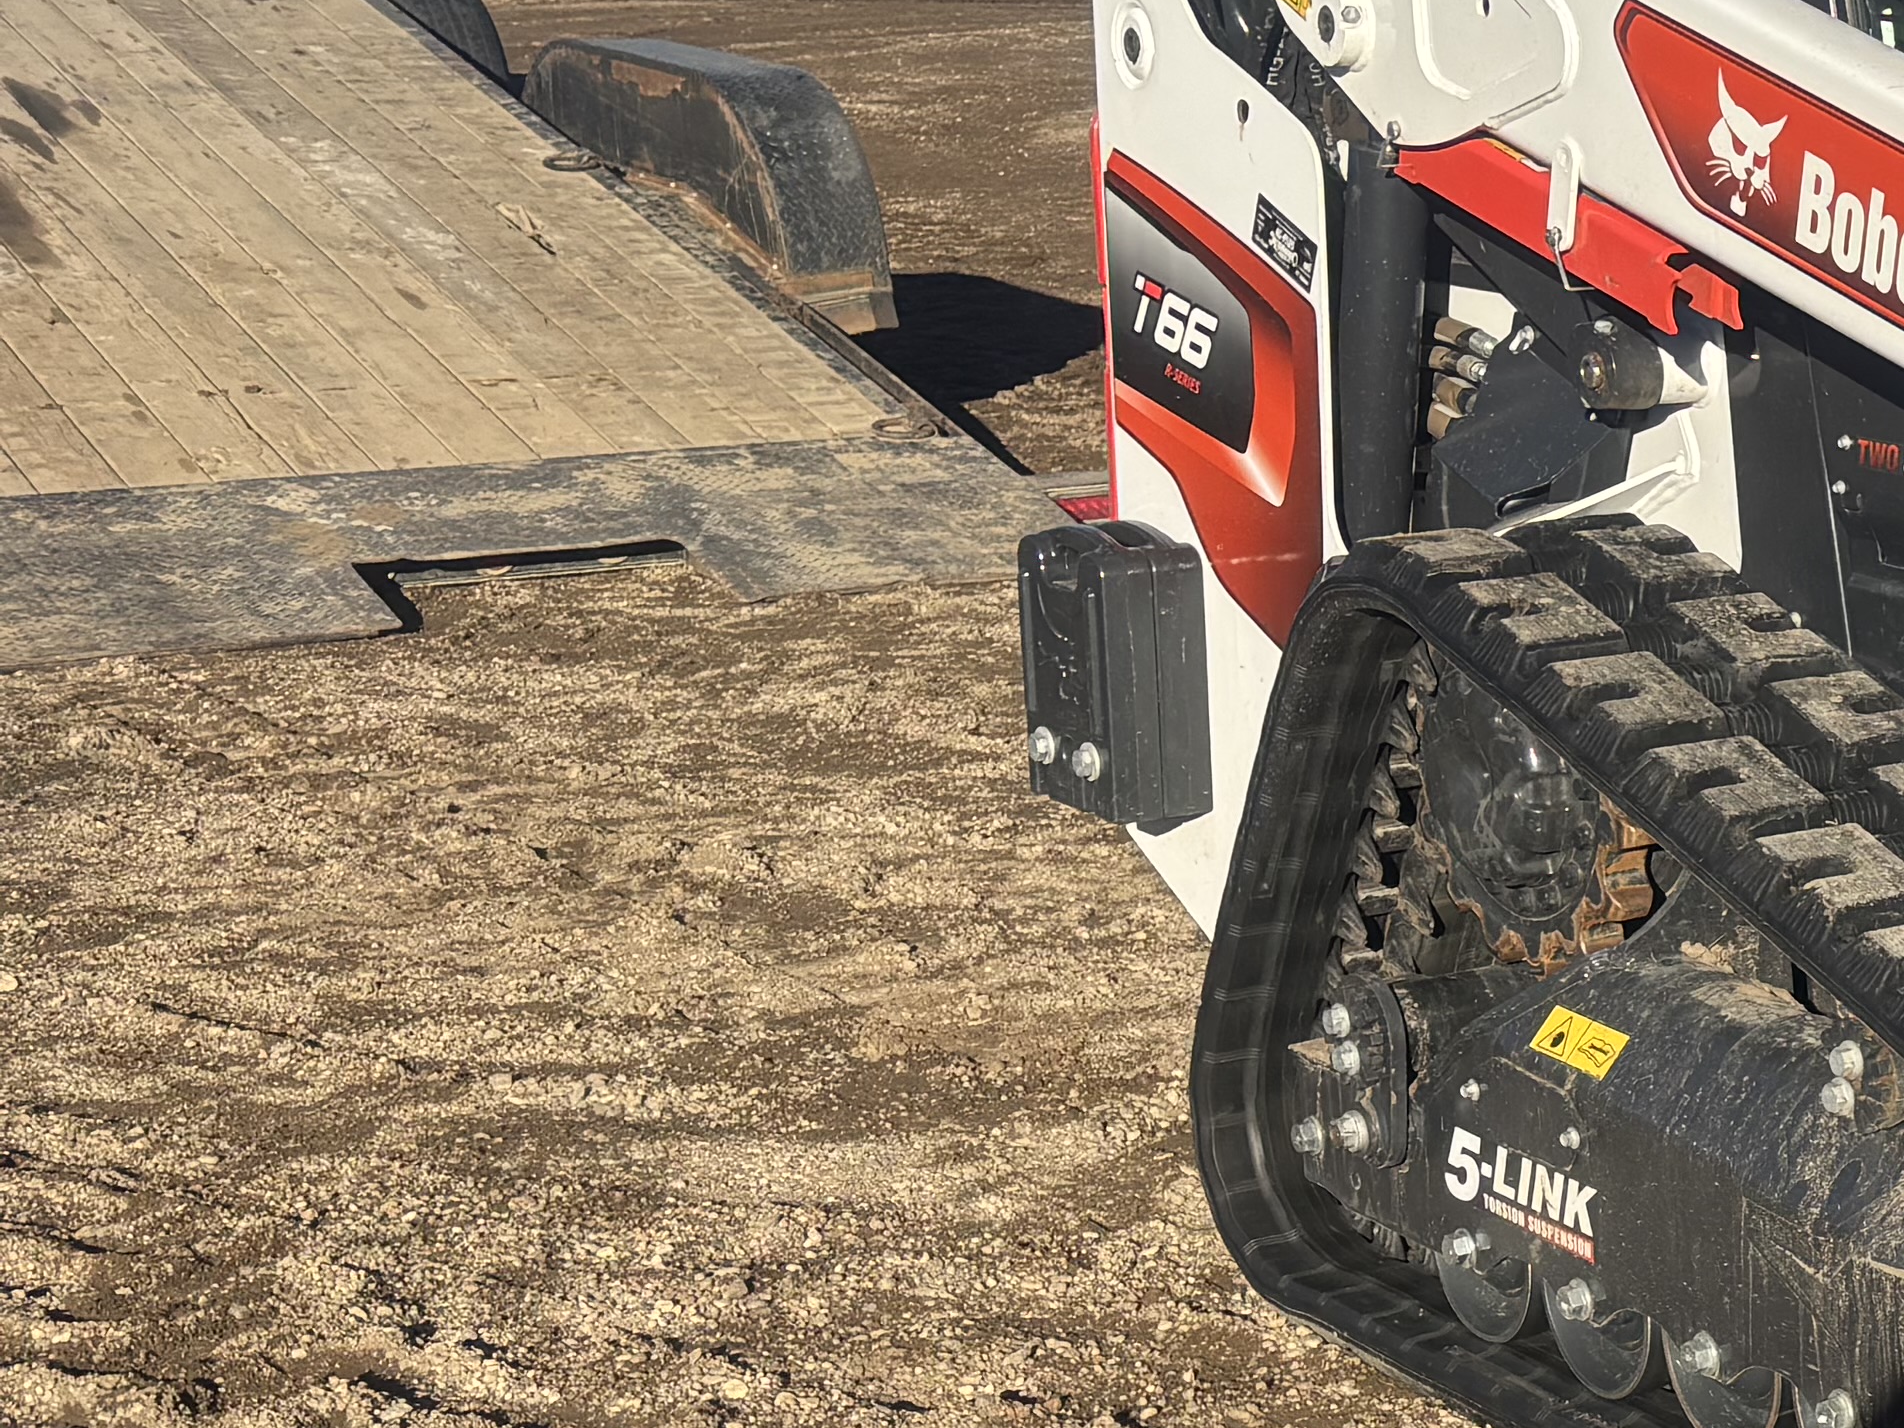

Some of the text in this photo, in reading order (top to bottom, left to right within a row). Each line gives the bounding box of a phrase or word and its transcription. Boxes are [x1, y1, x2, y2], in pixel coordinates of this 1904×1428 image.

[1133, 273, 1219, 370] T66
[1164, 362, 1201, 394] R-SERIES
[1857, 438, 1900, 474] TWO
[1444, 1125, 1598, 1238] 5-LINK
[1483, 1192, 1593, 1260] TORSION SUSPENSION
